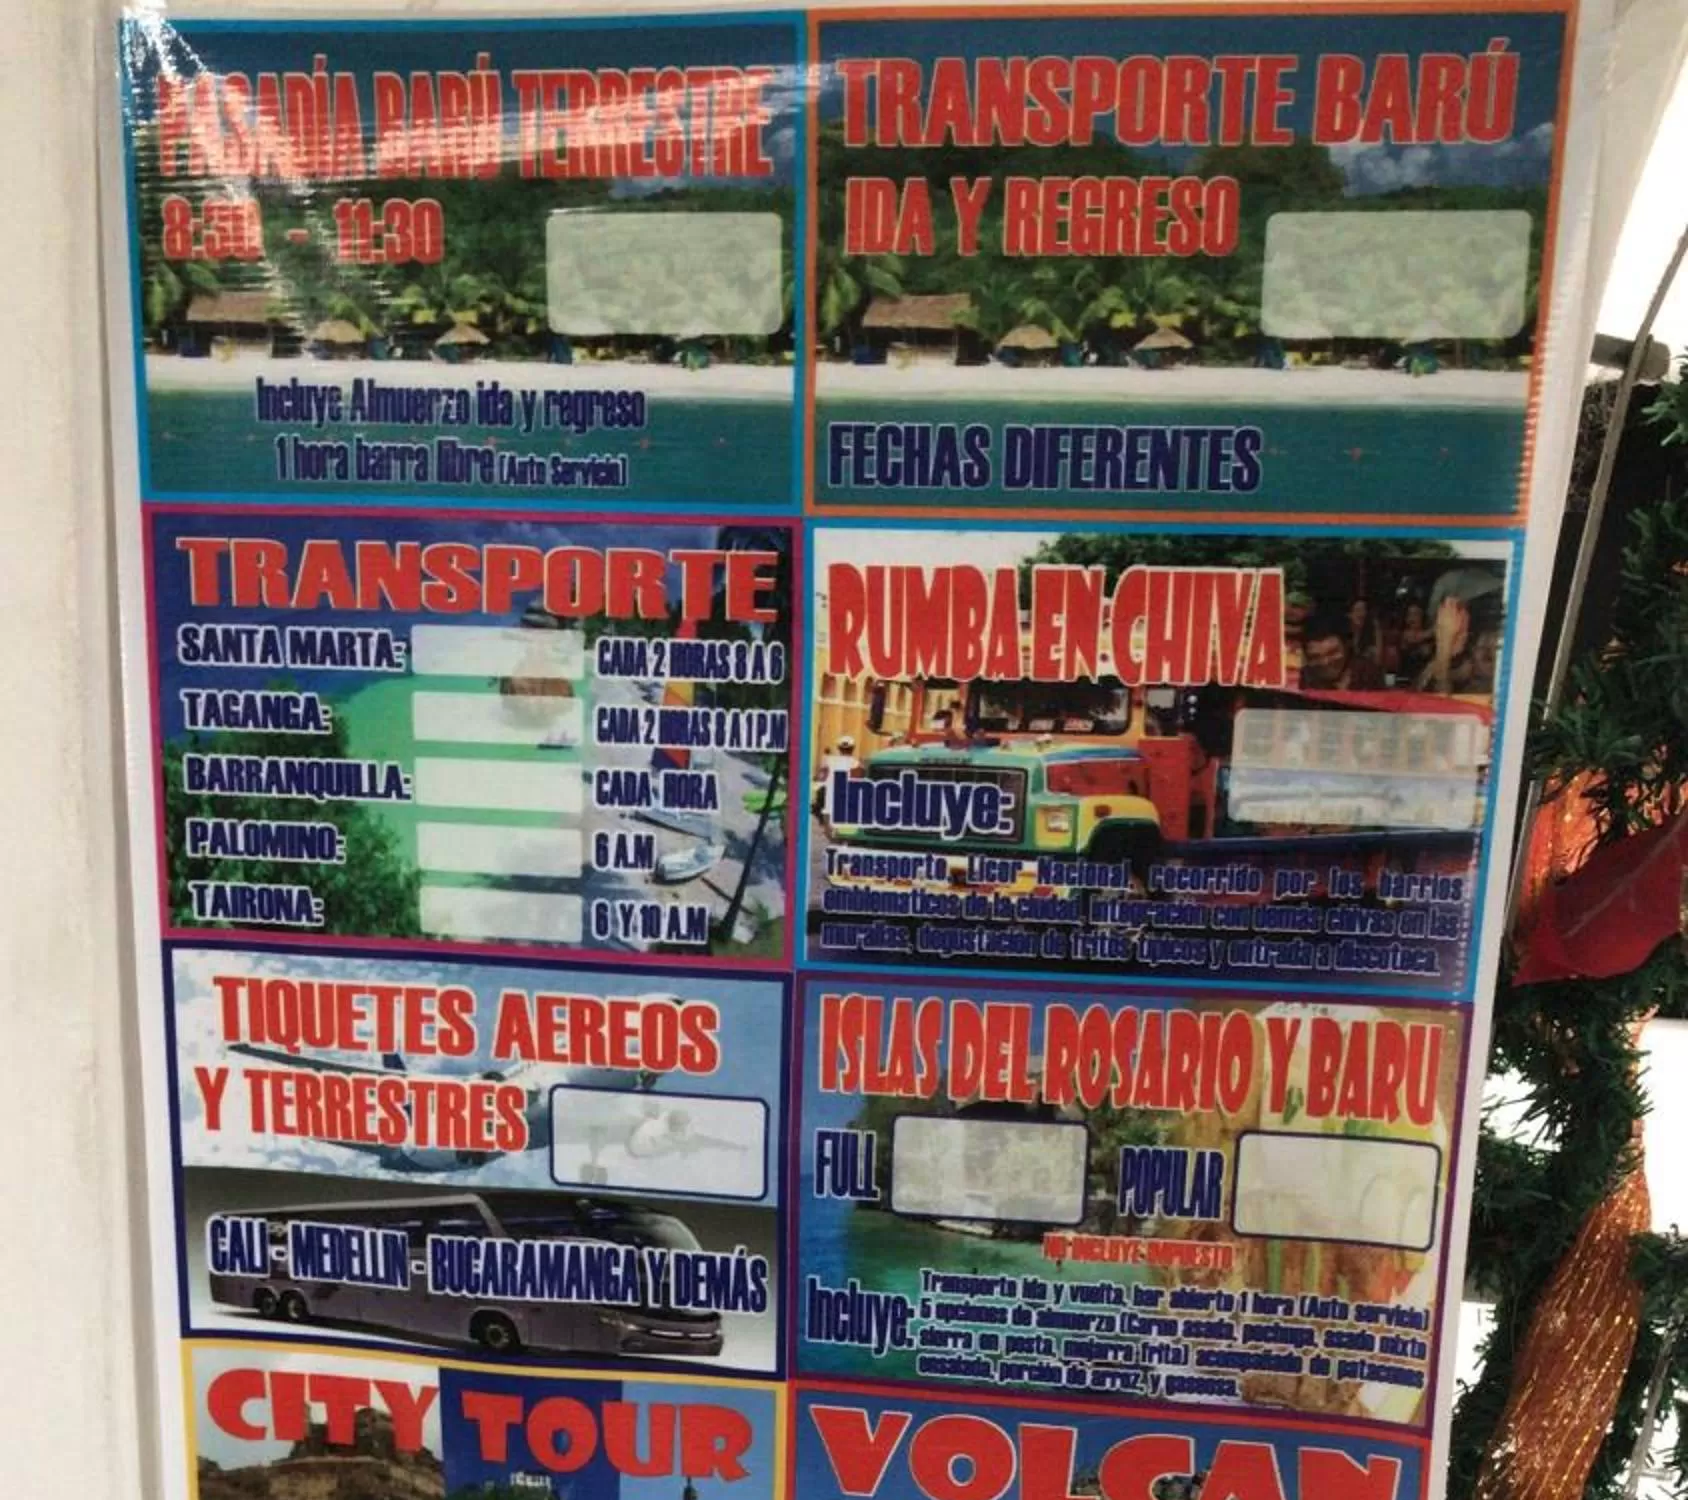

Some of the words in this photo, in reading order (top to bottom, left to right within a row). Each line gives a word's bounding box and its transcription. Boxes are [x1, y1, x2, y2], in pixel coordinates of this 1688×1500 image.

[512, 66, 774, 178] TERRESTRE
[837, 55, 1297, 148] TRANSPORTE
[1314, 37, 1520, 146] BARÚ
[333, 198, 444, 264] 11:30
[846, 177, 934, 257] IDA
[951, 177, 992, 257] Y
[1004, 176, 1240, 257] REGRESO
[256, 376, 342, 428] Incluye
[350, 378, 470, 426] Almuerzo
[476, 380, 513, 427] ida
[519, 388, 537, 433] y
[542, 388, 648, 432] regreso
[275, 434, 288, 481] 1
[291, 434, 349, 482] hora
[355, 435, 430, 483] barra
[435, 437, 496, 485] libre
[829, 422, 991, 489] FECHAS
[1004, 425, 1262, 493] DIFERENTES
[176, 537, 779, 623] TRANSPORTE
[178, 625, 283, 669] SANTA
[285, 628, 406, 674] MARTA:
[826, 562, 1020, 682] RUMBA
[1033, 565, 1105, 683] EN
[1111, 565, 1286, 688] CHIVA
[596, 636, 649, 679] CADA
[652, 639, 666, 678] 2
[669, 639, 731, 681] HORAS
[733, 640, 748, 682] 8
[751, 642, 767, 683] A
[768, 641, 785, 684] 6
[180, 690, 332, 734] TAGANGA:
[595, 705, 640, 745] CADA
[643, 706, 655, 746] 2
[658, 708, 711, 748] HORAS
[714, 708, 727, 749] 8
[728, 709, 742, 750] A
[745, 710, 753, 750] 1
[185, 755, 412, 804] BARRANQUILLA:
[595, 768, 651, 808] CADA
[661, 770, 720, 811] HORA
[828, 769, 1014, 838] Incluye:
[187, 819, 346, 865] PALOMINO:
[593, 830, 610, 870] 6
[613, 832, 656, 872] A.M
[190, 881, 325, 925] TAIRONA:
[967, 853, 1022, 885] Licor
[1150, 863, 1263, 894] recorrido
[1273, 868, 1318, 900] por
[1329, 866, 1365, 898] los
[1377, 868, 1464, 902] barrios
[592, 899, 611, 941] 6
[617, 900, 635, 941] Y
[639, 902, 662, 942] 10
[666, 903, 709, 945] A.M
[213, 975, 476, 1060] TIQUETES
[493, 992, 721, 1076] AEREOS
[820, 995, 942, 1097] ISLAS
[949, 1000, 1033, 1103] DEL
[1044, 1003, 1256, 1117] ROSARIO
[1265, 1016, 1302, 1115] Y
[1307, 1016, 1443, 1125] BARU
[195, 1066, 230, 1131] Y
[244, 1068, 530, 1153] TERRESTRES
[814, 1130, 880, 1199] FULL
[1118, 1146, 1225, 1220] POPULAR
[206, 1216, 268, 1277] CALI
[285, 1219, 409, 1289] MEDELLIN
[428, 1235, 640, 1304] BUCARAMANGA
[645, 1247, 671, 1308] Y
[673, 1244, 770, 1315] DEMÁS
[1052, 1281, 1066, 1305] y
[806, 1274, 916, 1357] Incluye:
[206, 1369, 441, 1452] CITY
[461, 1390, 754, 1482] TOUR
